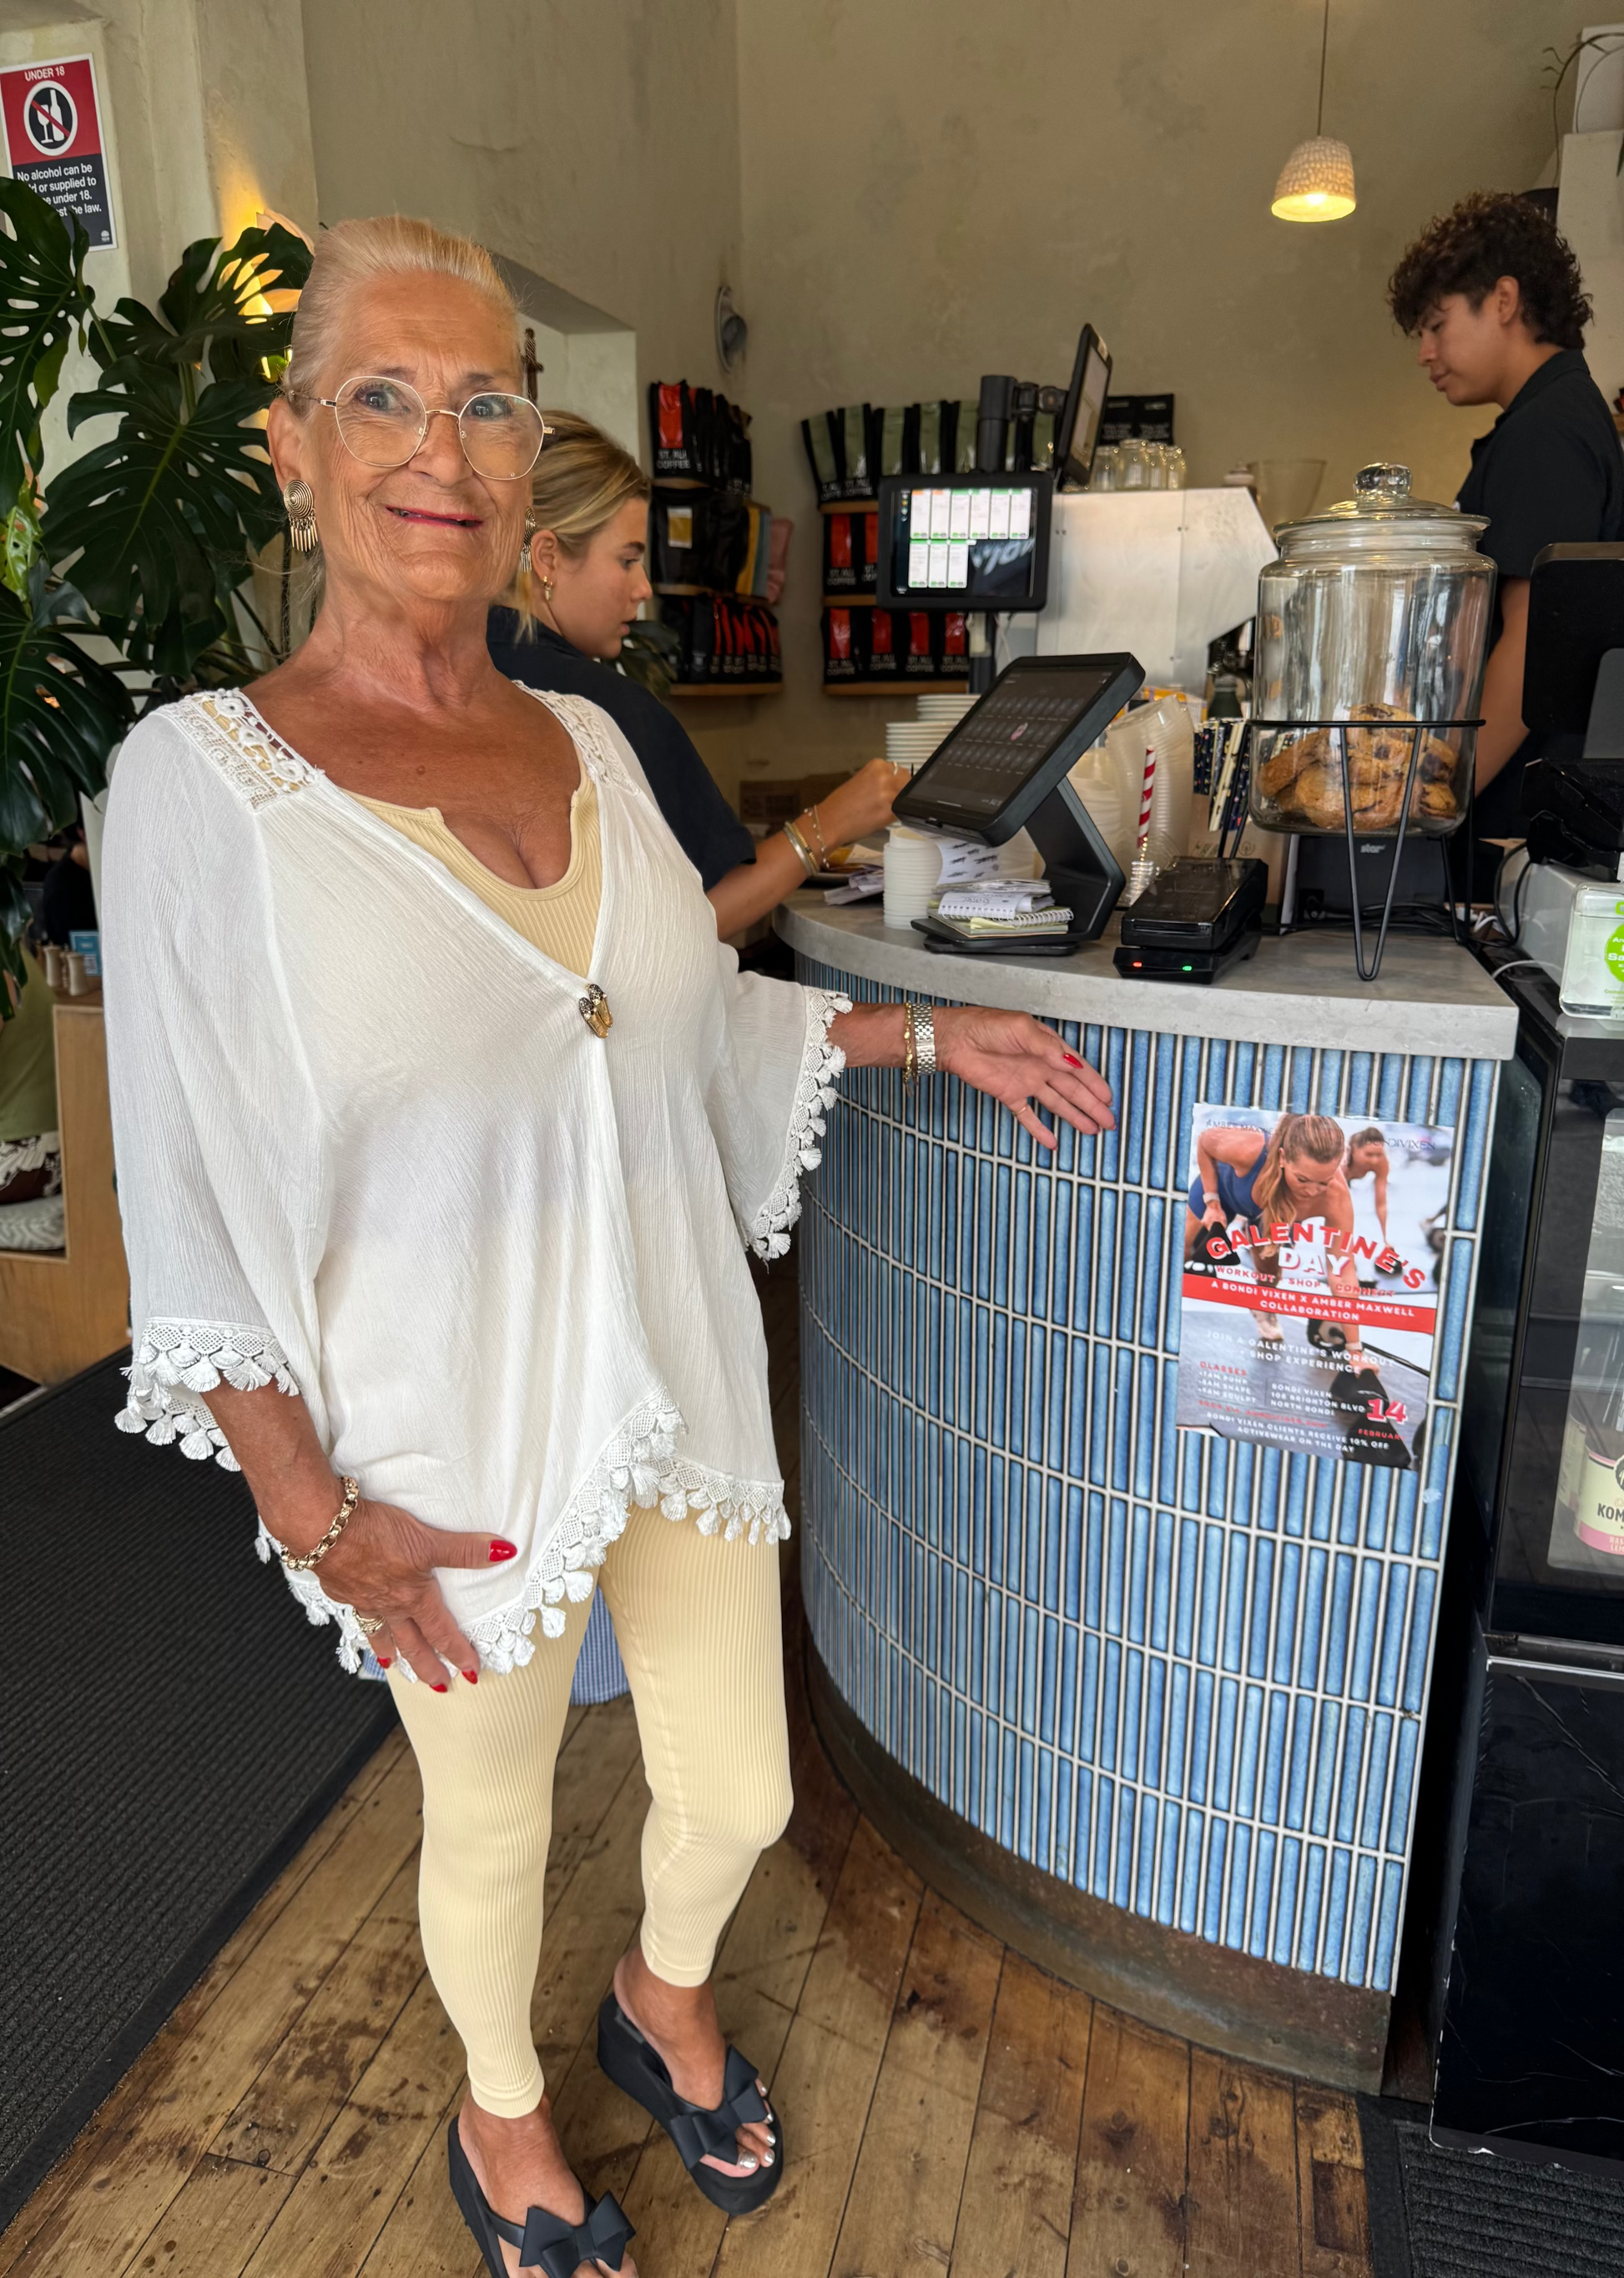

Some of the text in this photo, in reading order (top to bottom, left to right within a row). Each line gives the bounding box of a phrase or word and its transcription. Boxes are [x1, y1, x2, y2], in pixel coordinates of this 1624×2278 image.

[24, 66, 65, 82] UNDER 18
[17, 163, 93, 181] No alcohol can be
[38, 184, 48, 193] or
[49, 177, 86, 192] supplied
[87, 177, 97, 187] to
[53, 192, 78, 204] under
[79, 189, 93, 201] 18.
[84, 203, 102, 214] law.
[1206, 1119, 1237, 1130] AMBER
[1206, 1222, 1425, 1290] GALENTINE'S
[1279, 1246, 1351, 1277] DAY
[1216, 1266, 1396, 1298] WORKOUT SHOP CONNECT
[1211, 1280, 1415, 1317] A BONDI VIXEN X AMBER MAXWELL
[1259, 1300, 1359, 1321] COLLABORATION
[1207, 1329, 1233, 1342] JOIN
[1248, 1338, 1327, 1358] GALENTINE'S
[1331, 1351, 1394, 1367] WORKOUT
[1200, 1361, 1246, 1377] CLASSES
[1249, 1350, 1361, 1375] SHOP EXPERIENCE
[1272, 1383, 1332, 1399] BONDI VIXEN
[1270, 1399, 1334, 1417] NORTH BONDI
[1289, 1394, 1338, 1409] BRIGHTON
[1340, 1402, 1366, 1414] BLVD
[1366, 1397, 1408, 1425] 14
[1207, 1412, 1235, 1423] BONDI
[1237, 1418, 1265, 1429] VIXEN
[1267, 1424, 1305, 1435] CLIENTS
[1308, 1430, 1347, 1444] RECEIVE
[1237, 1426, 1355, 1454] ACTIVEWEAR ON THE DAY
